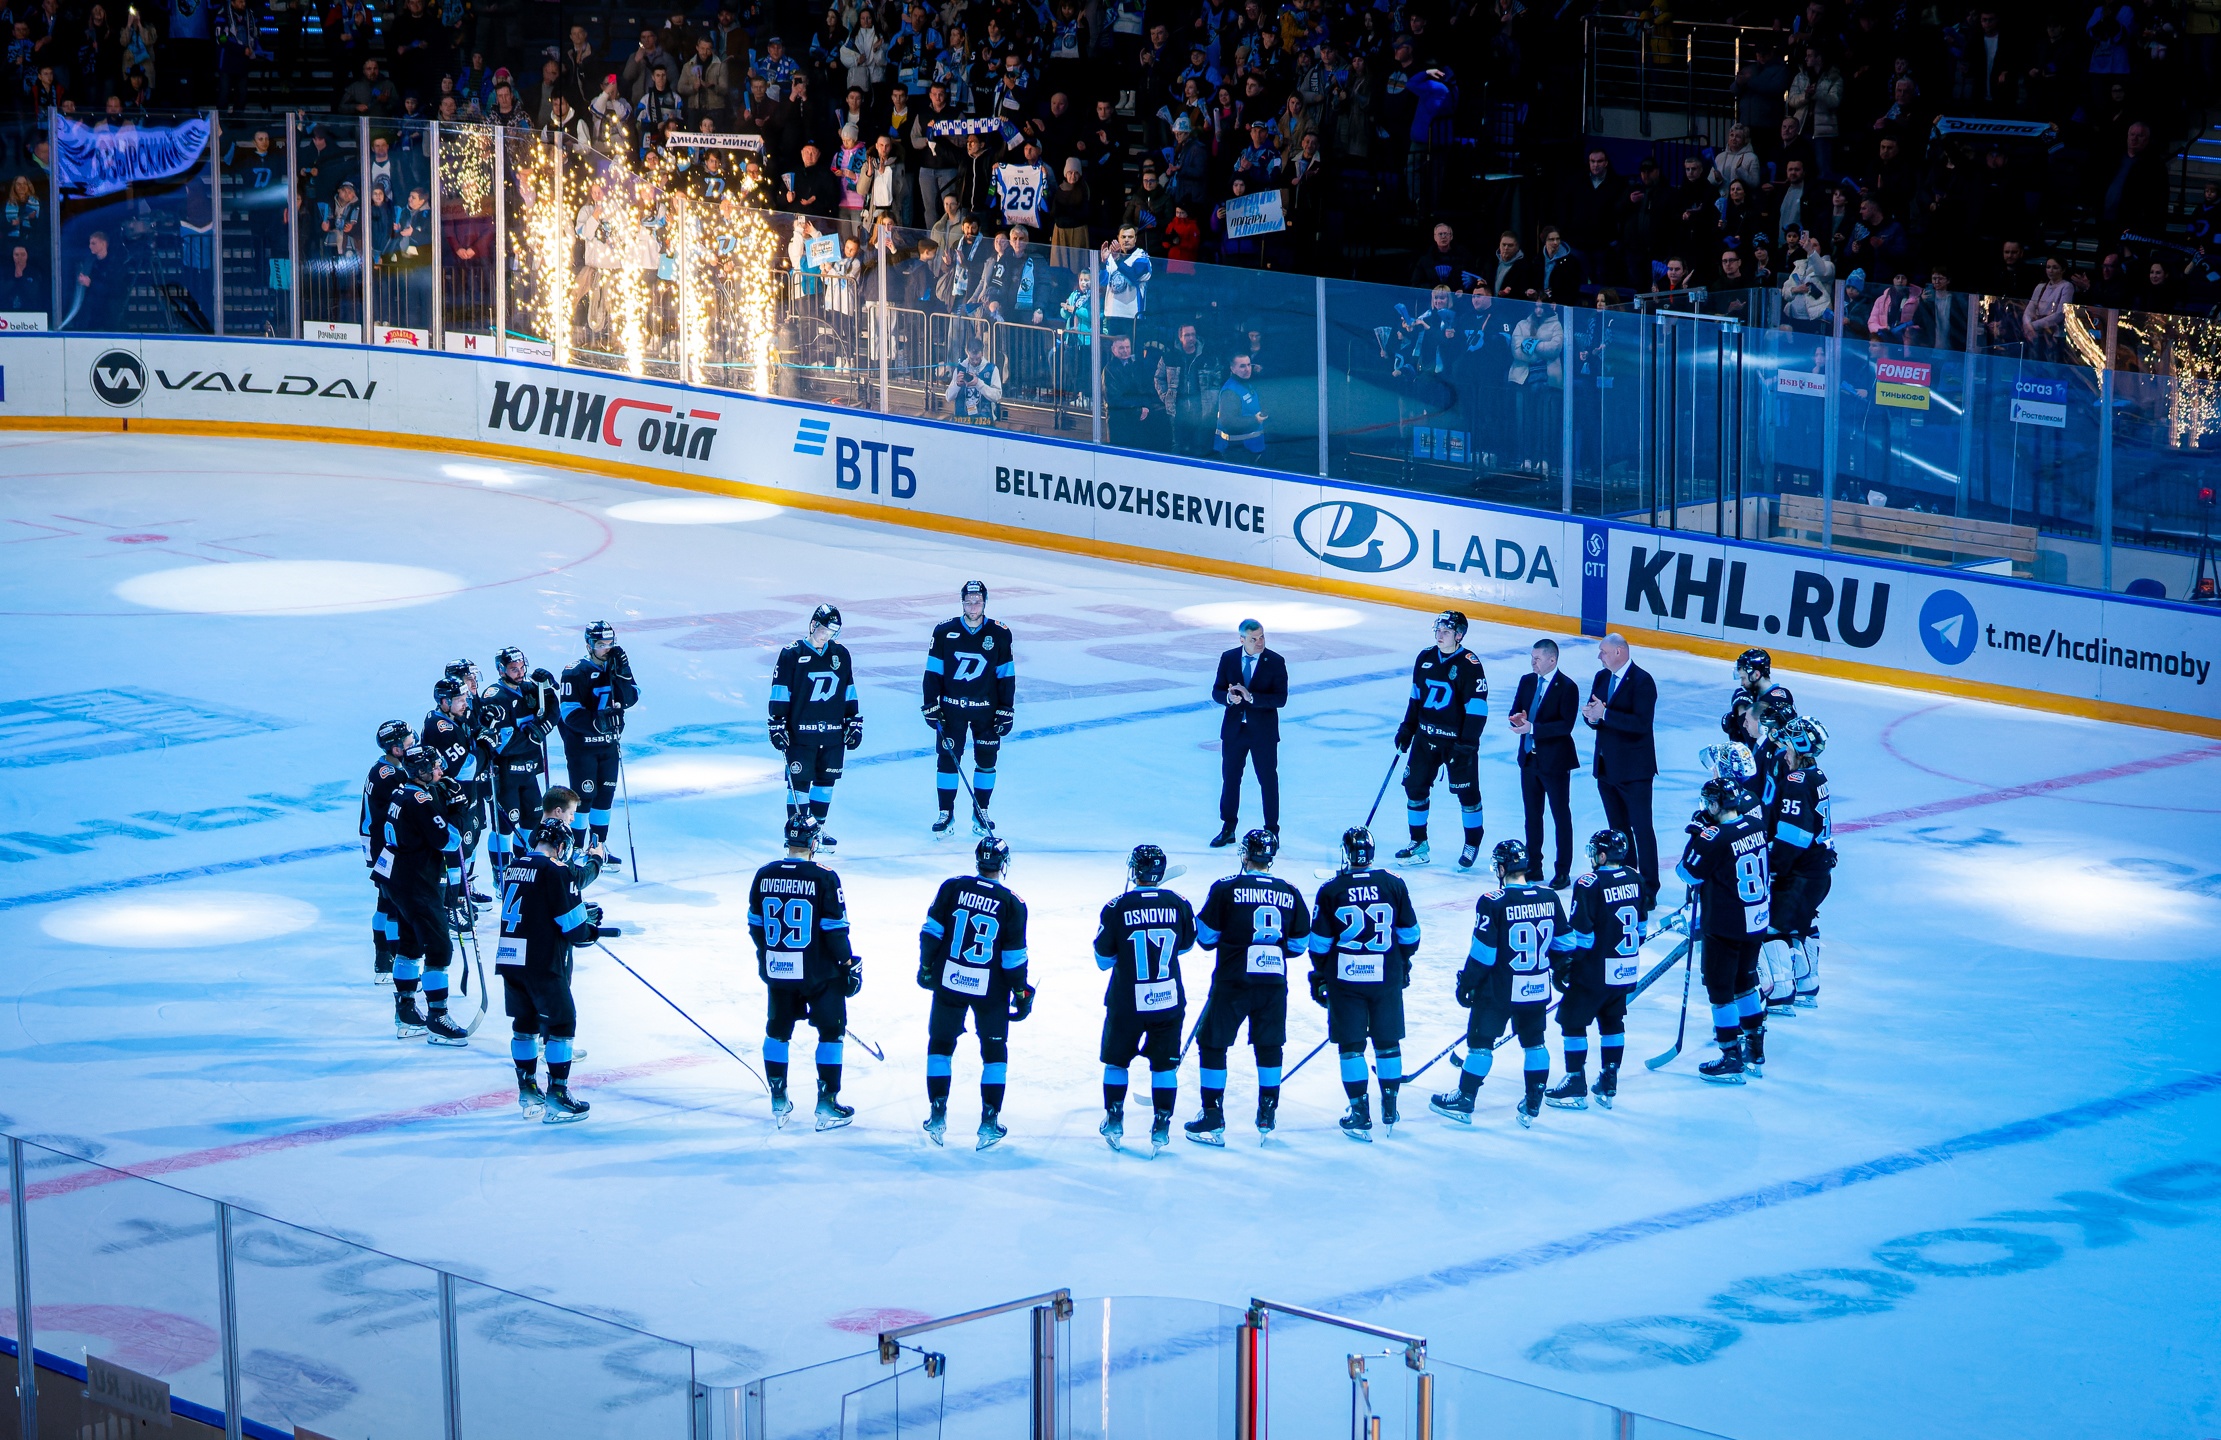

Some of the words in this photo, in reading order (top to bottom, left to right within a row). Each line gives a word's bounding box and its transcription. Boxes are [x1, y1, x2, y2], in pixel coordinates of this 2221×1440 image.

[1013, 177, 1030, 186] STAS
[1006, 186, 1036, 211] 23
[9, 321, 39, 332] belbet
[317, 329, 348, 341] Рэчыцкае
[1779, 378, 1799, 388] BSB
[1877, 363, 1930, 382] FONBET
[154, 368, 378, 401] VALDAI
[2015, 380, 2053, 397] согаз
[1880, 389, 1926, 403] ТИНЬКОФФ
[2021, 410, 2064, 424] Ростелеком
[835, 436, 916, 499] ВТБ
[995, 465, 1265, 534] BELTAMOZHSERVICE
[1432, 529, 1559, 589] LADA
[1624, 546, 1890, 649] KHL.RU
[1986, 623, 2210, 685] t.me/hcdinamoby
[1475, 678, 1488, 693] 26
[1435, 728, 1458, 738] Bank
[445, 742, 467, 762] 56
[1781, 798, 1802, 816] 35
[983, 851, 991, 860] 13
[1357, 856, 1367, 864] 23
[1735, 847, 1770, 904] 81
[957, 890, 1000, 916] MOROZ
[1233, 888, 1294, 910] SHINKEVICH
[1348, 885, 1379, 903] STAS
[501, 882, 523, 933] 4
[1123, 907, 1177, 926] OSNOVIN
[1506, 901, 1555, 921] GORBUNOV
[761, 896, 814, 949] 69
[1252, 905, 1283, 945] 8
[1334, 902, 1394, 952] 23
[1614, 905, 1640, 956] 3
[949, 908, 1000, 965] 13
[1508, 918, 1555, 972] 92
[1127, 928, 1177, 981] 17
